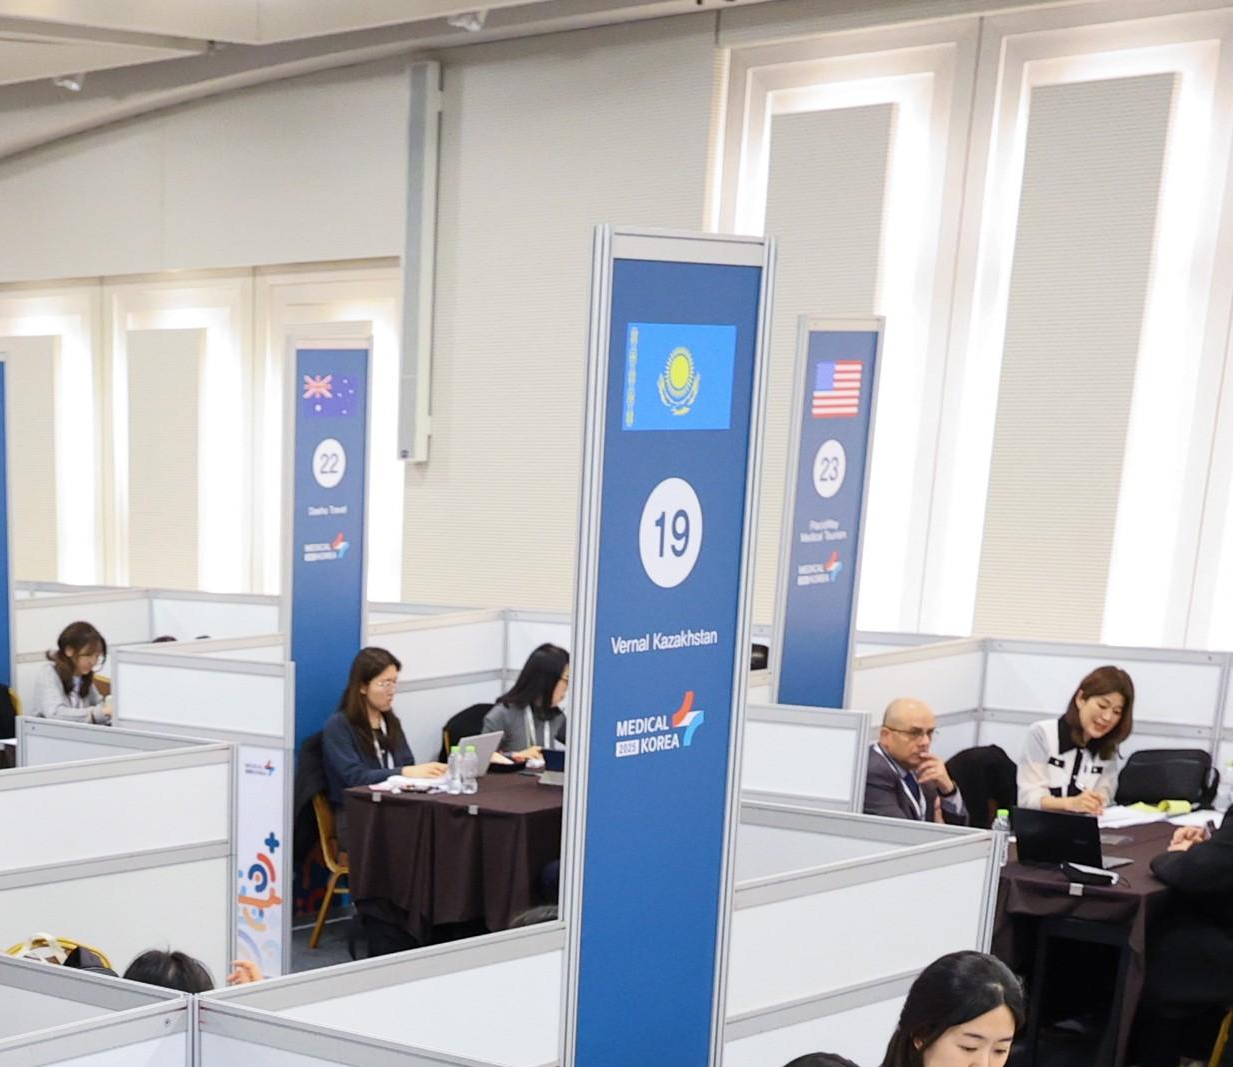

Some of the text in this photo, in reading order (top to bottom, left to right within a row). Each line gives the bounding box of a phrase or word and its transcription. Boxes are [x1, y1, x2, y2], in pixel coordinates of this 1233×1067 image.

[320, 453, 339, 474] 22
[819, 457, 839, 481] 23
[655, 509, 691, 558] 19
[611, 629, 718, 654] Vernal Kazakhstan
[616, 715, 669, 736] MEDICAL
[640, 733, 679, 753] KOREA
